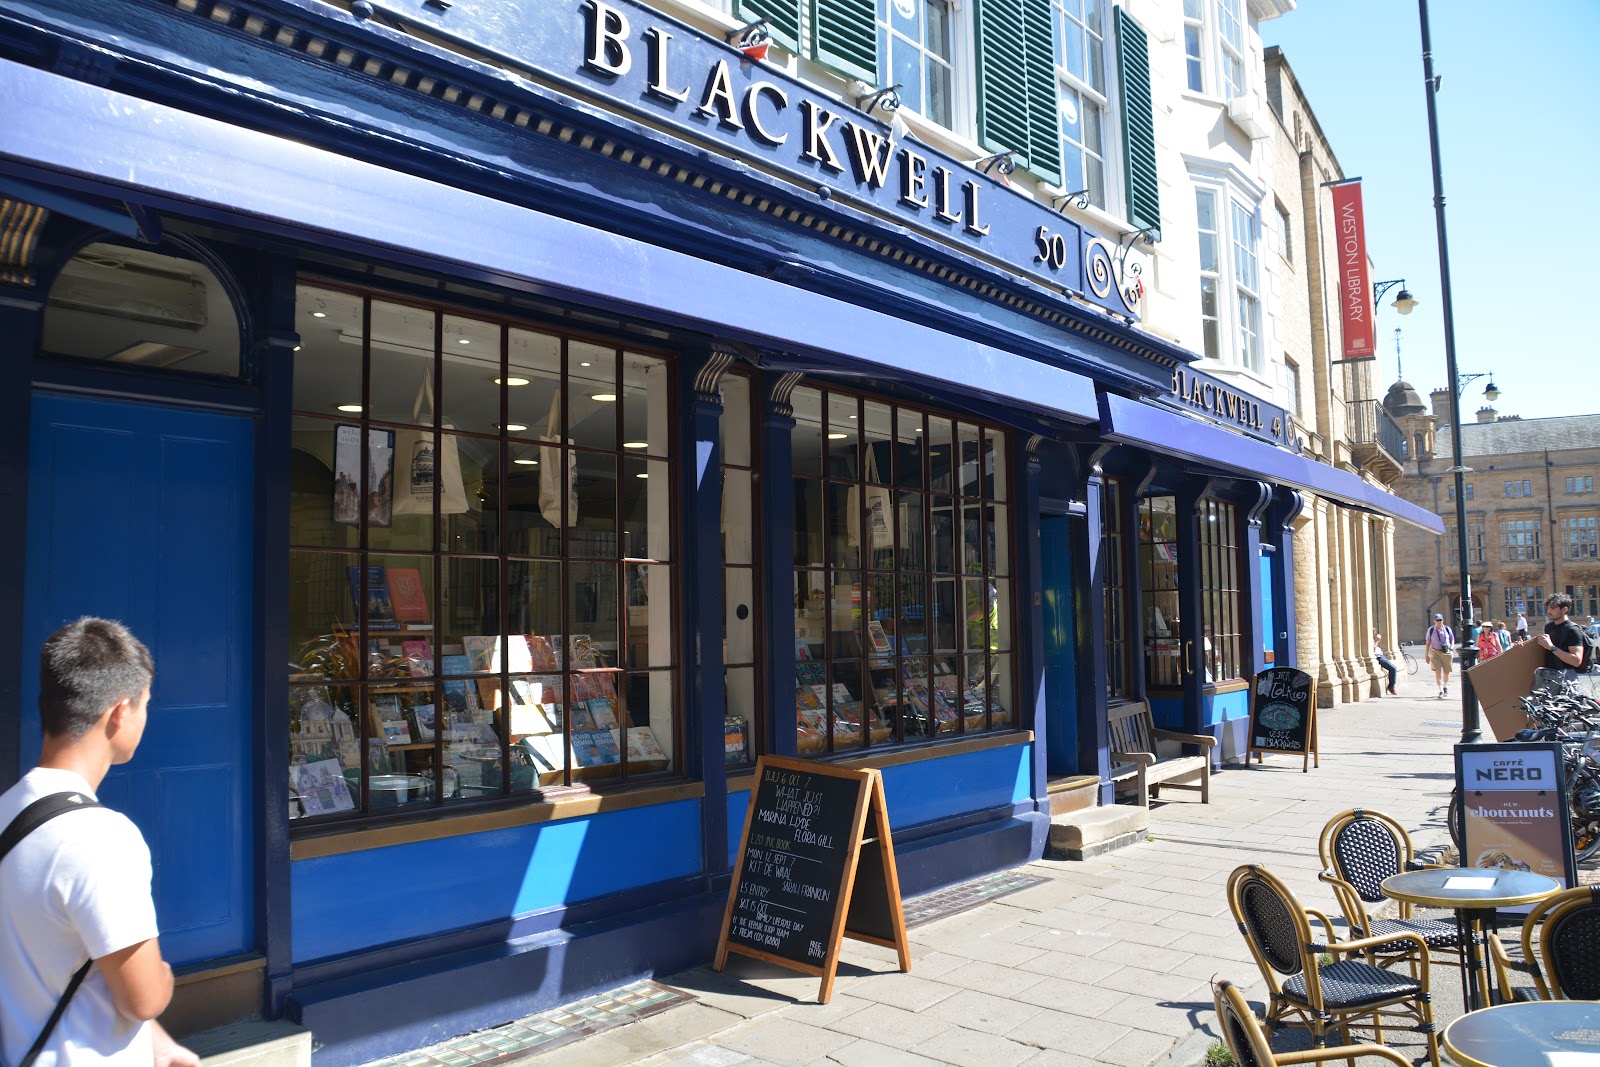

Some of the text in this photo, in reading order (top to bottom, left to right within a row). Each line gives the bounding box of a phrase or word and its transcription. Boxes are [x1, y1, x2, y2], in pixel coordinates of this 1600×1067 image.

[583, 1, 1067, 270] BLACKWELL 50
[1342, 202, 1363, 322] WESTON LIBRARY
[1171, 370, 1264, 430] BLACKWELL
[1476, 768, 1542, 781] NERO
[776, 785, 823, 804] WHAT JUST
[1470, 806, 1554, 818] chouxnuts
[794, 829, 834, 849] FLORA GILL
[747, 848, 763, 860] MON
[749, 860, 763, 872] KIT
[764, 863, 773, 877] DE
[749, 884, 770, 897] ENTRY
[807, 947, 826, 959] ENTRY
